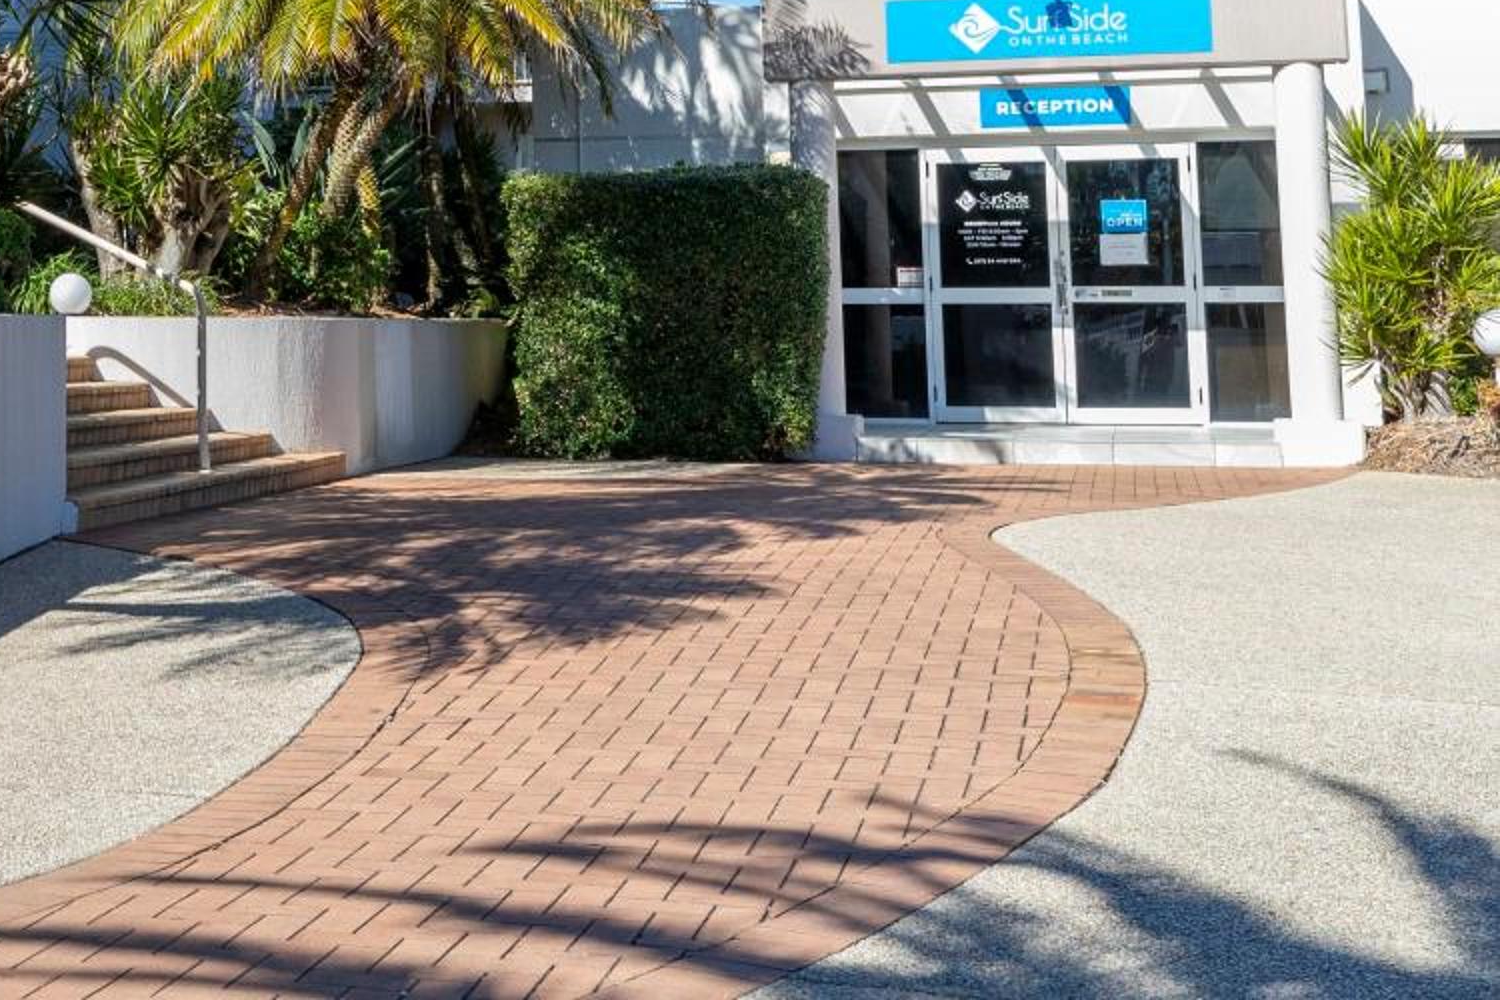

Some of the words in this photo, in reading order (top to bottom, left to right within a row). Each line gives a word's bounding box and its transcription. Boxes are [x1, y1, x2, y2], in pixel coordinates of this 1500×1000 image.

[1008, 36, 1032, 48] ON
[1036, 34, 1067, 46] THE
[1071, 32, 1128, 45] BEACH
[996, 98, 1114, 116] RECEPTION
